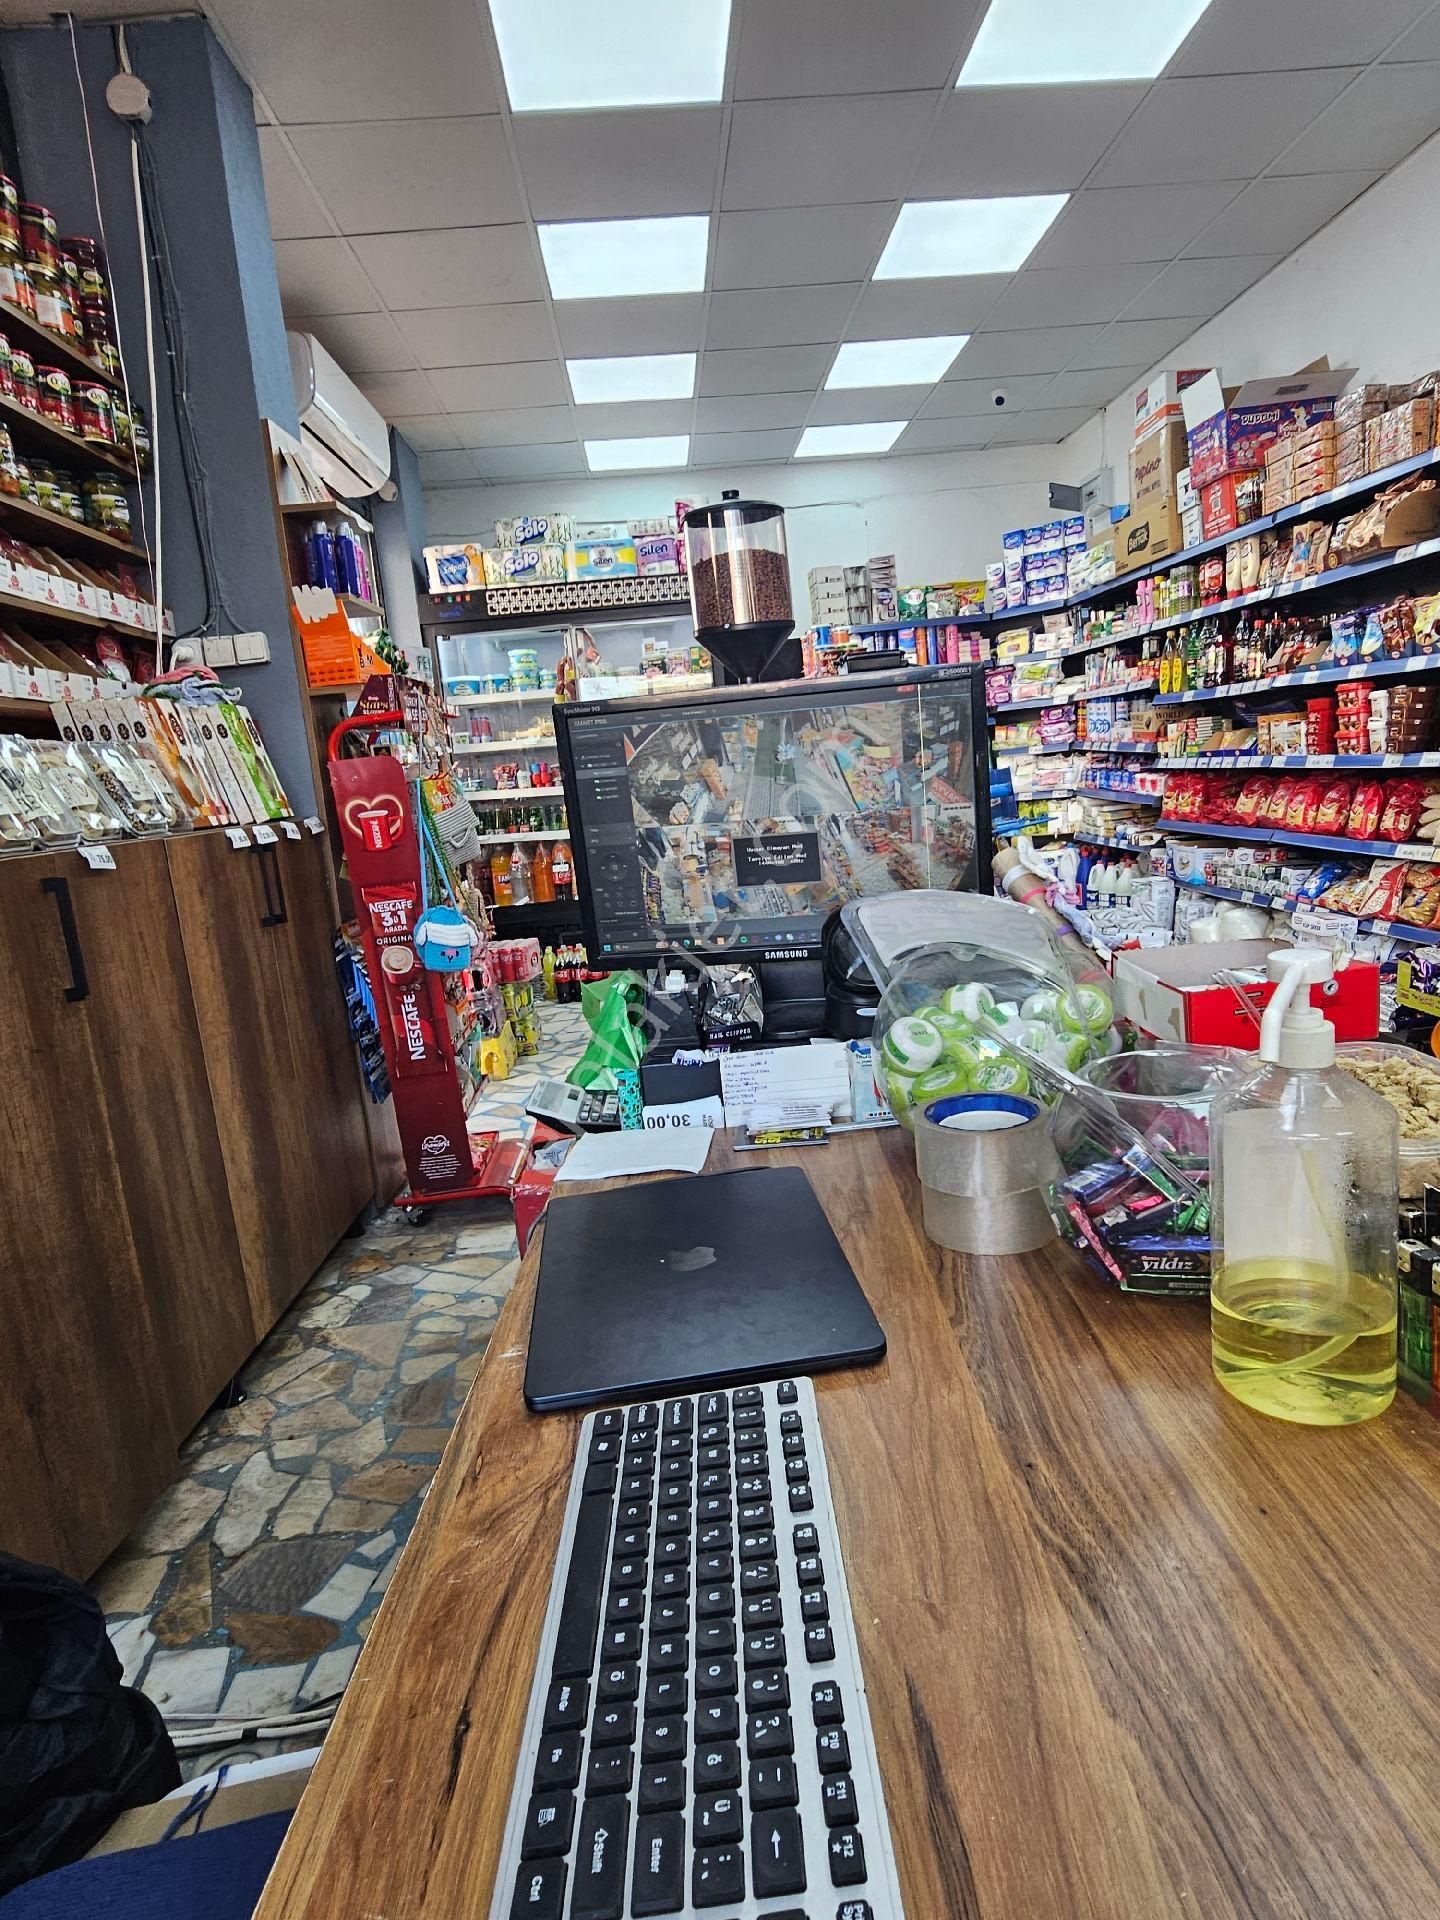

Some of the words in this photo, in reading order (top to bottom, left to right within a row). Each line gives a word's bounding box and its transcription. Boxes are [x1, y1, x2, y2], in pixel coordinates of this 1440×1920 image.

[515, 519, 548, 543] Solo
[640, 544, 668, 557] Silen
[505, 552, 539, 575] Solo
[384, 925, 408, 934] ARADA
[376, 935, 413, 945] ORIGINA
[764, 949, 808, 959] SAMSUNG
[646, 1114, 691, 1129] 30,00
[708, 1427, 718, 1437] Q
[671, 1439, 680, 1447] A
[708, 1449, 718, 1458] W
[633, 1456, 643, 1465] Z
[670, 1462, 679, 1470] S
[630, 1480, 640, 1489] X
[708, 1475, 718, 1484] E
[669, 1487, 678, 1495] D
[743, 1482, 752, 1490] 4
[627, 1507, 637, 1516] C
[668, 1514, 677, 1522] F
[625, 1534, 634, 1543] V
[708, 1529, 719, 1538] T
[666, 1542, 675, 1552] G
[745, 1538, 756, 1547] 6
[709, 1559, 718, 1567] Y
[746, 1569, 757, 1577] 7
[709, 1591, 720, 1601] U
[663, 1609, 673, 1617] J
[749, 1604, 759, 1612] 8
[815, 1628, 825, 1639] F8
[661, 1644, 671, 1654] K
[751, 1640, 761, 1649] 9
[709, 1666, 720, 1675] O
[611, 1671, 624, 1681] Ö
[659, 1684, 670, 1693] L
[753, 1680, 763, 1689] 0
[820, 1689, 833, 1701] F9
[606, 1713, 617, 1723] Ç
[709, 1708, 720, 1718] P
[656, 1727, 667, 1737] Ş
[825, 1732, 839, 1748] F10
[552, 1749, 562, 1762] Fn
[707, 1754, 721, 1765] Ğ
[833, 1781, 846, 1799] F11
[715, 1800, 730, 1812] Ü
[839, 1835, 854, 1857] F12
[651, 1838, 662, 1873] Enter
